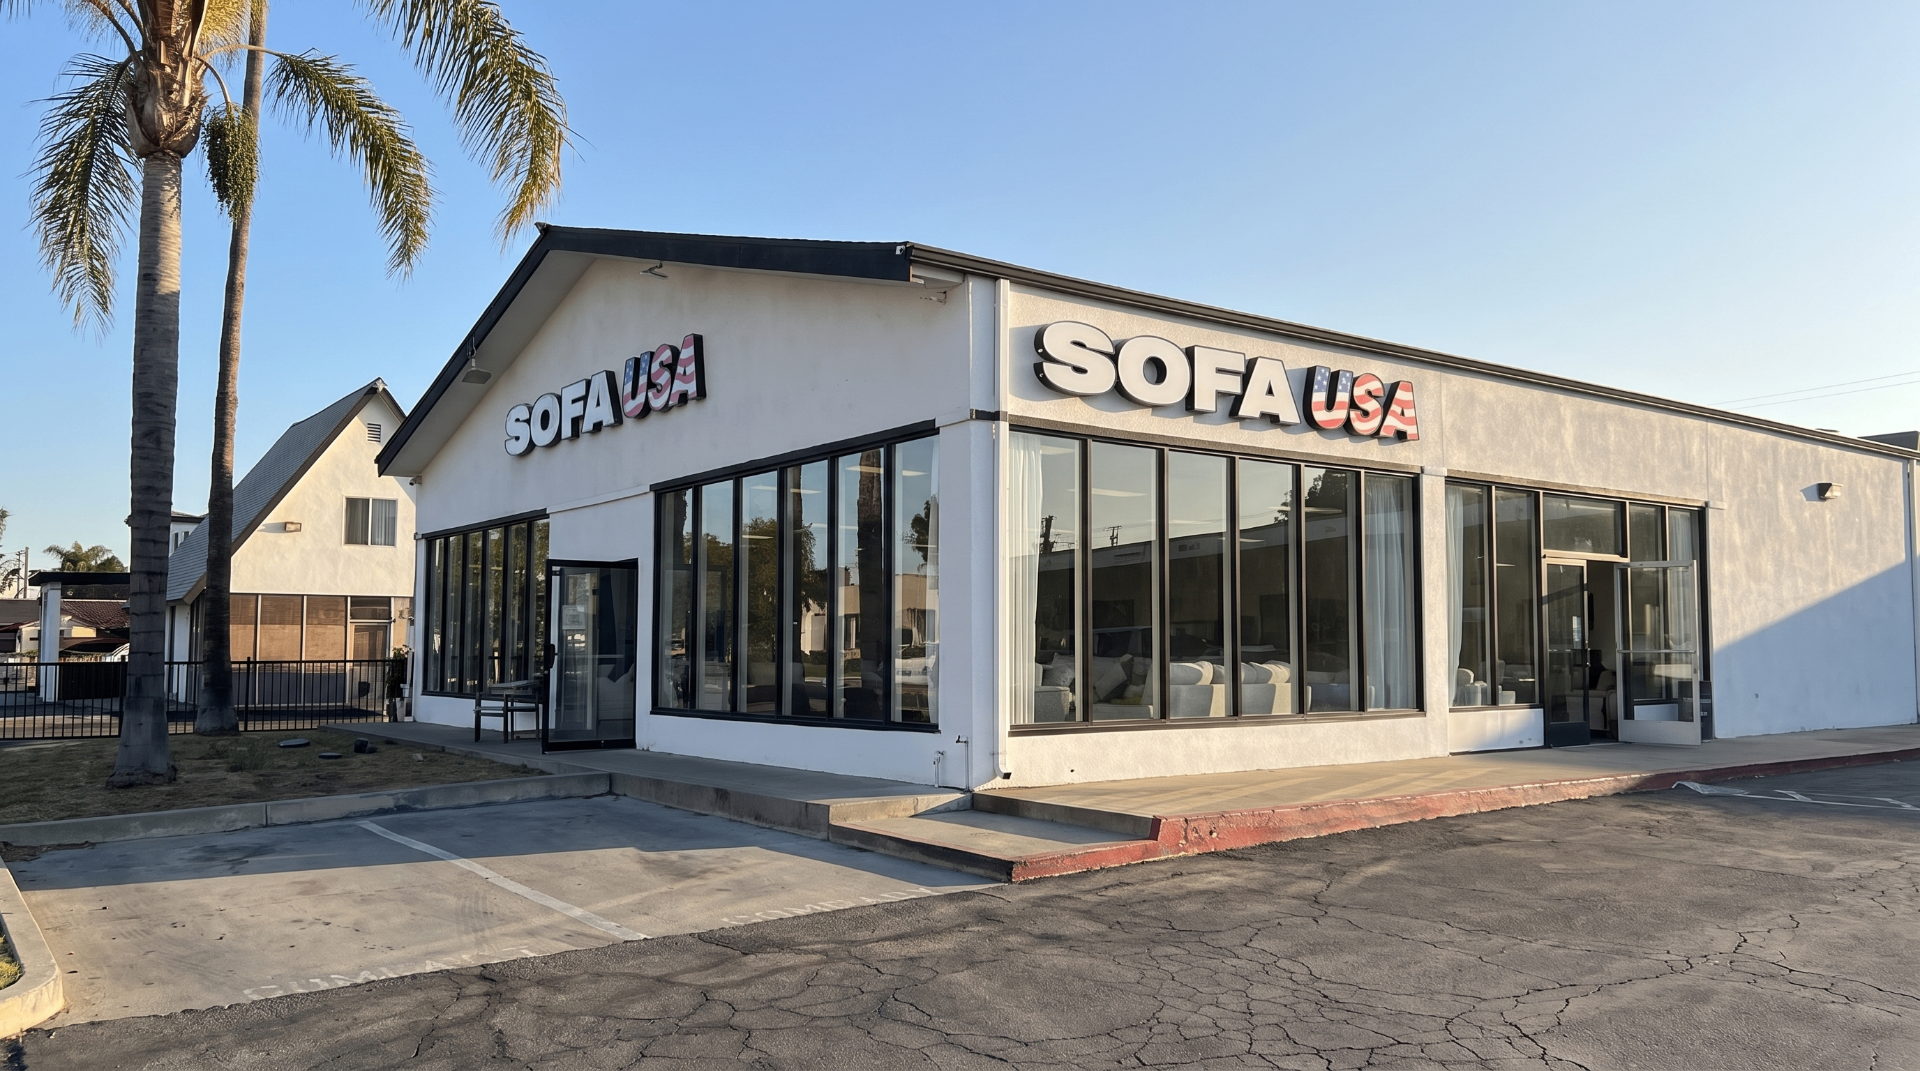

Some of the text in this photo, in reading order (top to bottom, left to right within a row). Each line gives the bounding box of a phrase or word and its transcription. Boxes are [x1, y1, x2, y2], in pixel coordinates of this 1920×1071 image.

[505, 333, 706, 456] SOFA USA
[1034, 320, 1420, 440] SOFA USA
